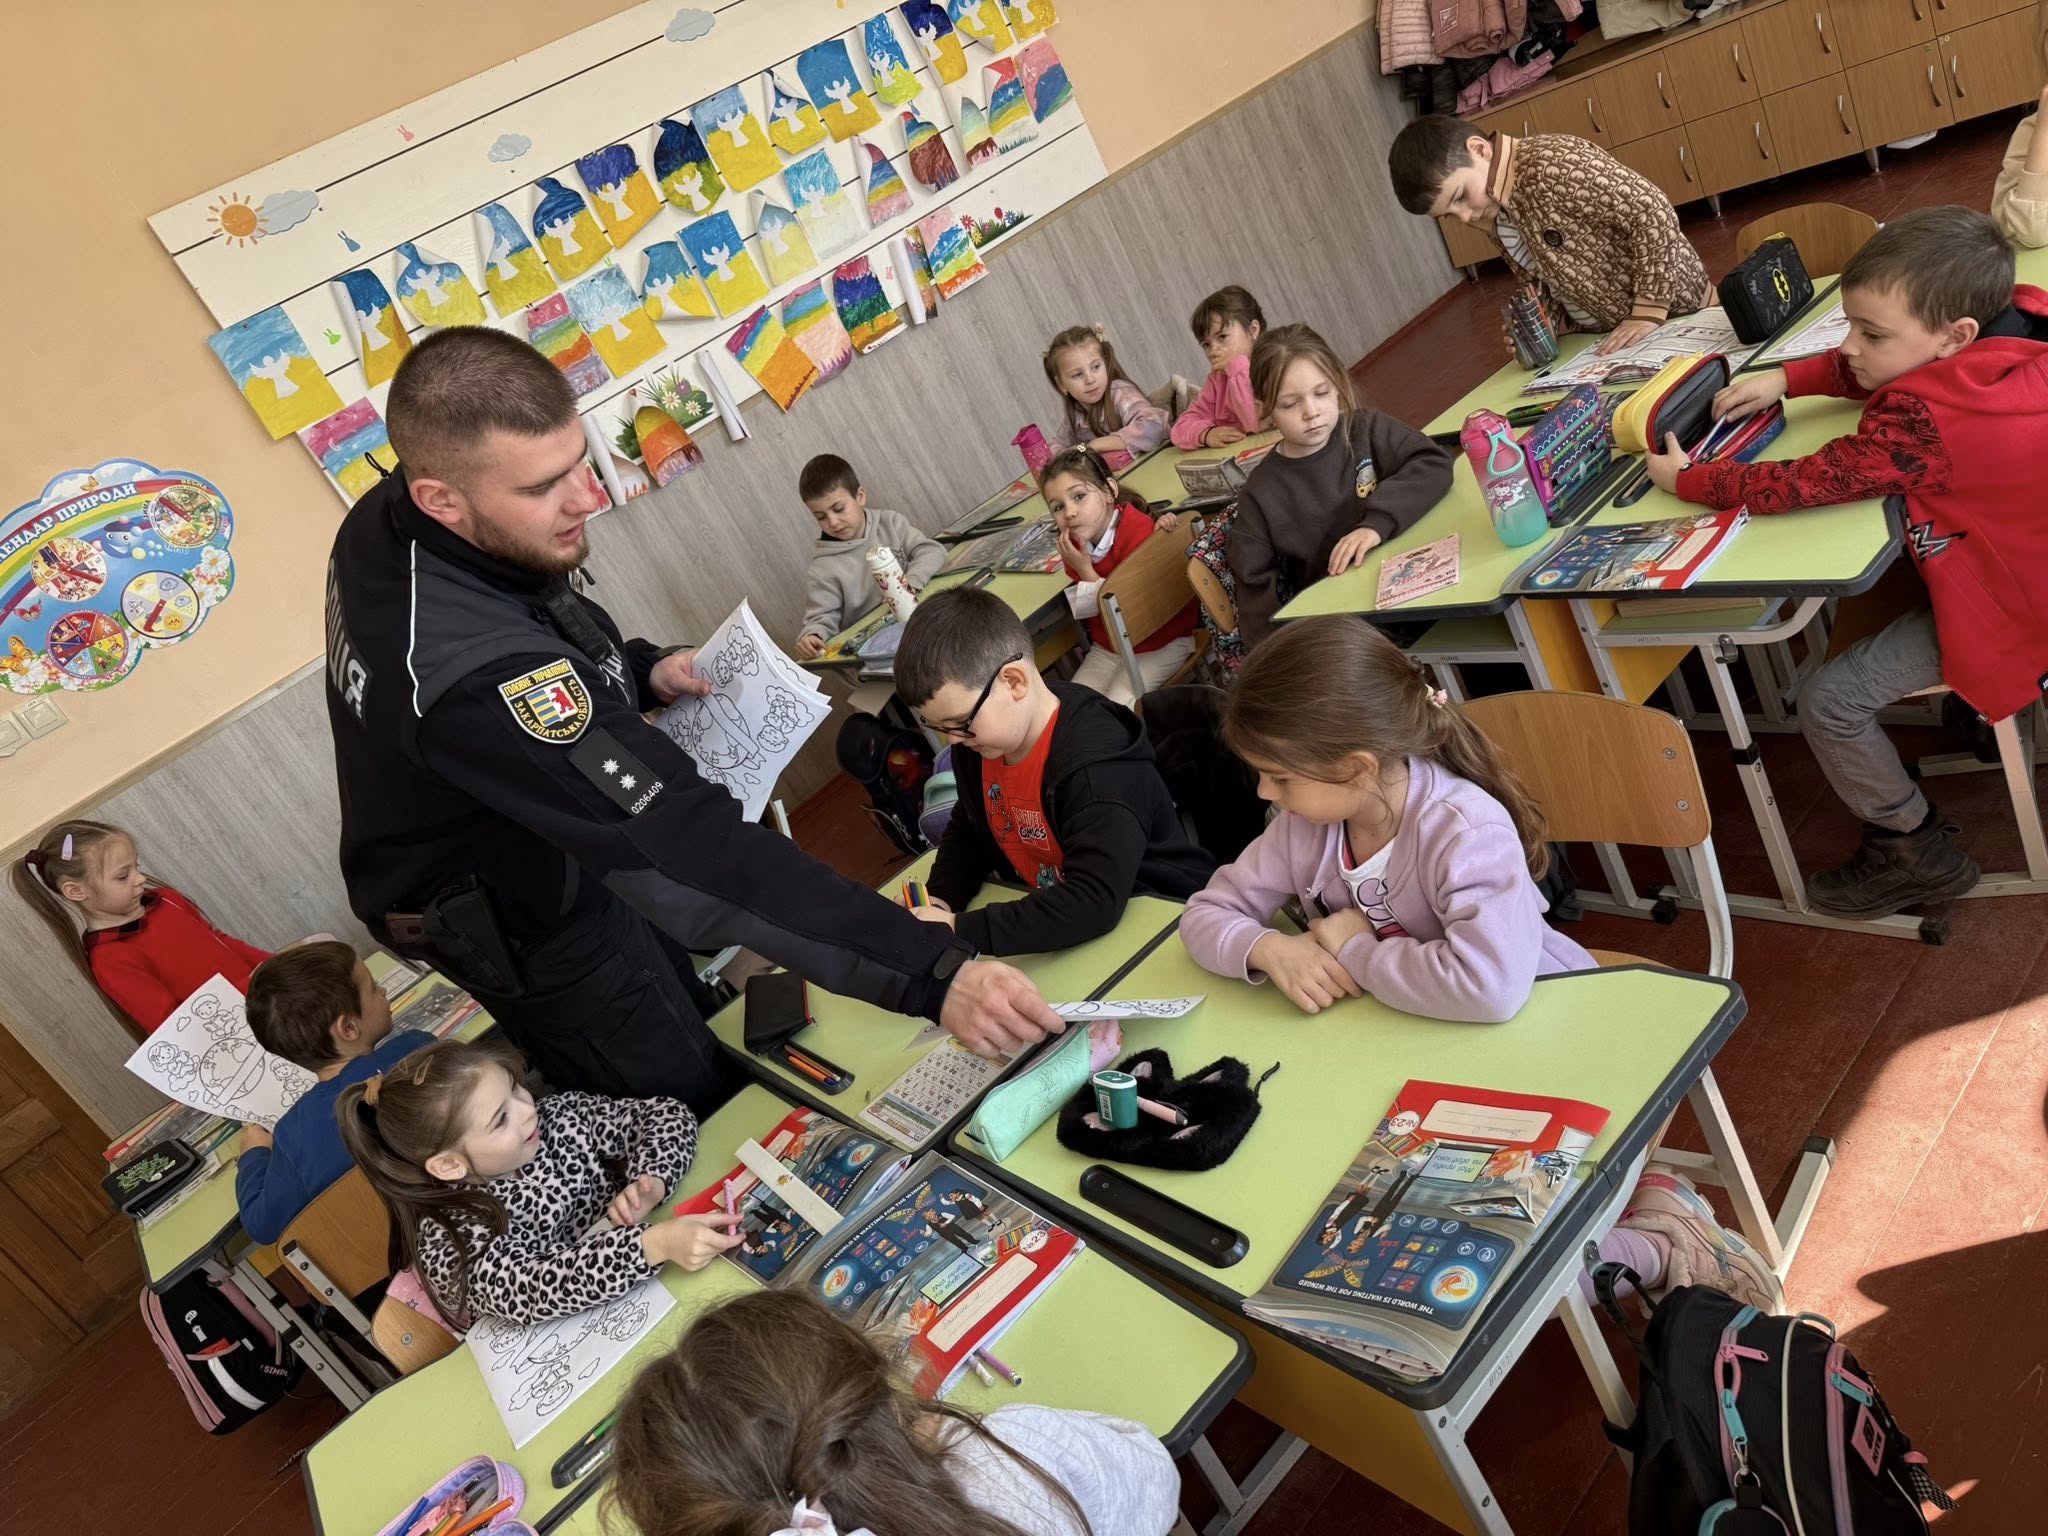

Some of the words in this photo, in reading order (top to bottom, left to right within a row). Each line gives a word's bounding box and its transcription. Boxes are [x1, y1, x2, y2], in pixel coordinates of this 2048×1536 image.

[56, 483, 138, 522] ПРИРОДИ
[514, 700, 581, 738] ЗАКАРПАТСЬКА
[568, 678, 589, 720] ОБЛАСТЬ
[630, 781, 664, 814] 0206409
[1390, 1115, 1417, 1131] №23
[822, 1257, 835, 1269] THE
[833, 1239, 855, 1259] WORLD
[852, 1233, 861, 1242] IS
[858, 1213, 885, 1237] WAITING
[883, 1205, 896, 1216] FOR
[895, 1196, 906, 1207] THE
[905, 1179, 929, 1200] WINGED
[1020, 1229, 1048, 1252] №23
[1297, 1278, 1325, 1290] WINGED
[1324, 1284, 1338, 1292] THE
[1338, 1287, 1352, 1296] FOR
[1352, 1289, 1382, 1302] WAITING
[1382, 1295, 1391, 1304] IS
[1390, 1297, 1418, 1310] WORLD
[1417, 1304, 1433, 1314] THE
